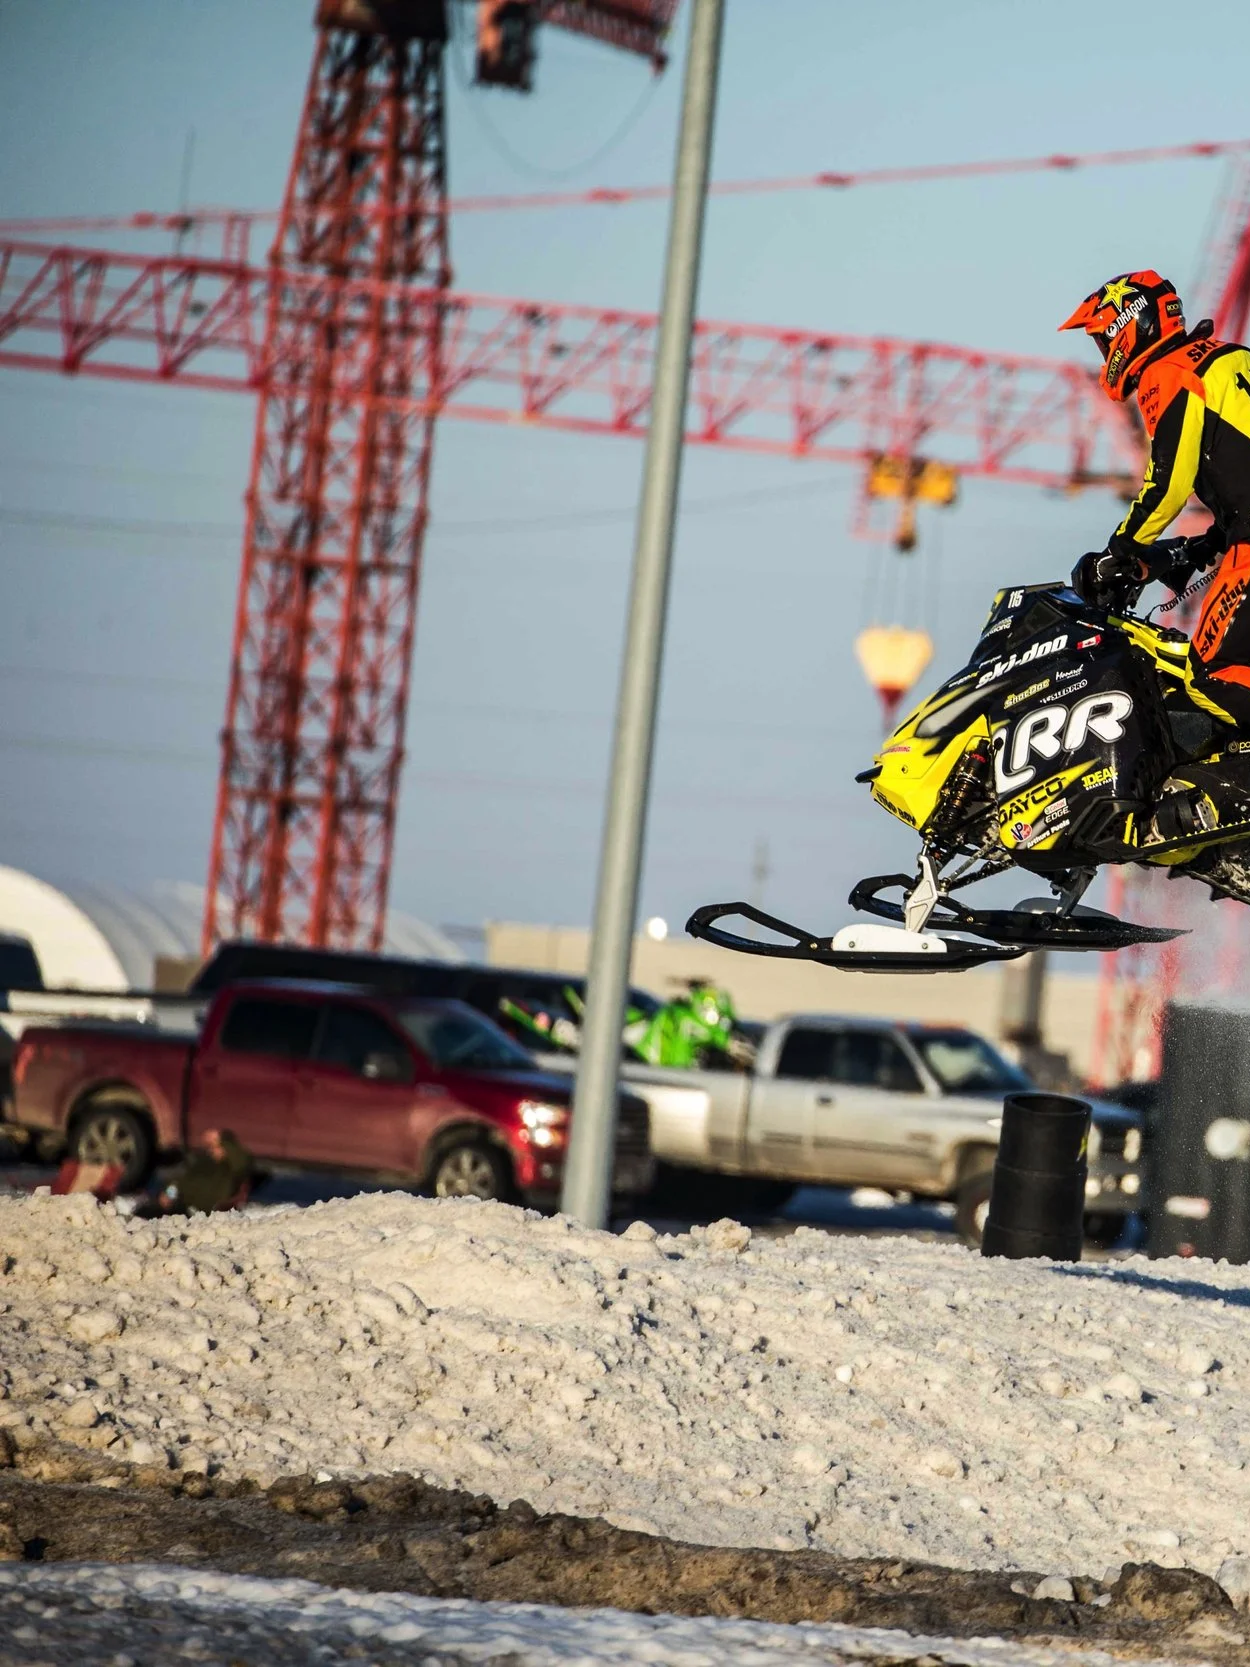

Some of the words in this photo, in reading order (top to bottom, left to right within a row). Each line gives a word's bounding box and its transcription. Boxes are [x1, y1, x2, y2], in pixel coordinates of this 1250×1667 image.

[1117, 295, 1148, 330] DRAGON
[1008, 589, 1025, 609] 115
[975, 634, 1069, 689] ski-doo
[1081, 766, 1118, 788] IDEAL
[999, 777, 1067, 826] DAYCO
[1045, 806, 1070, 823] EDGE
